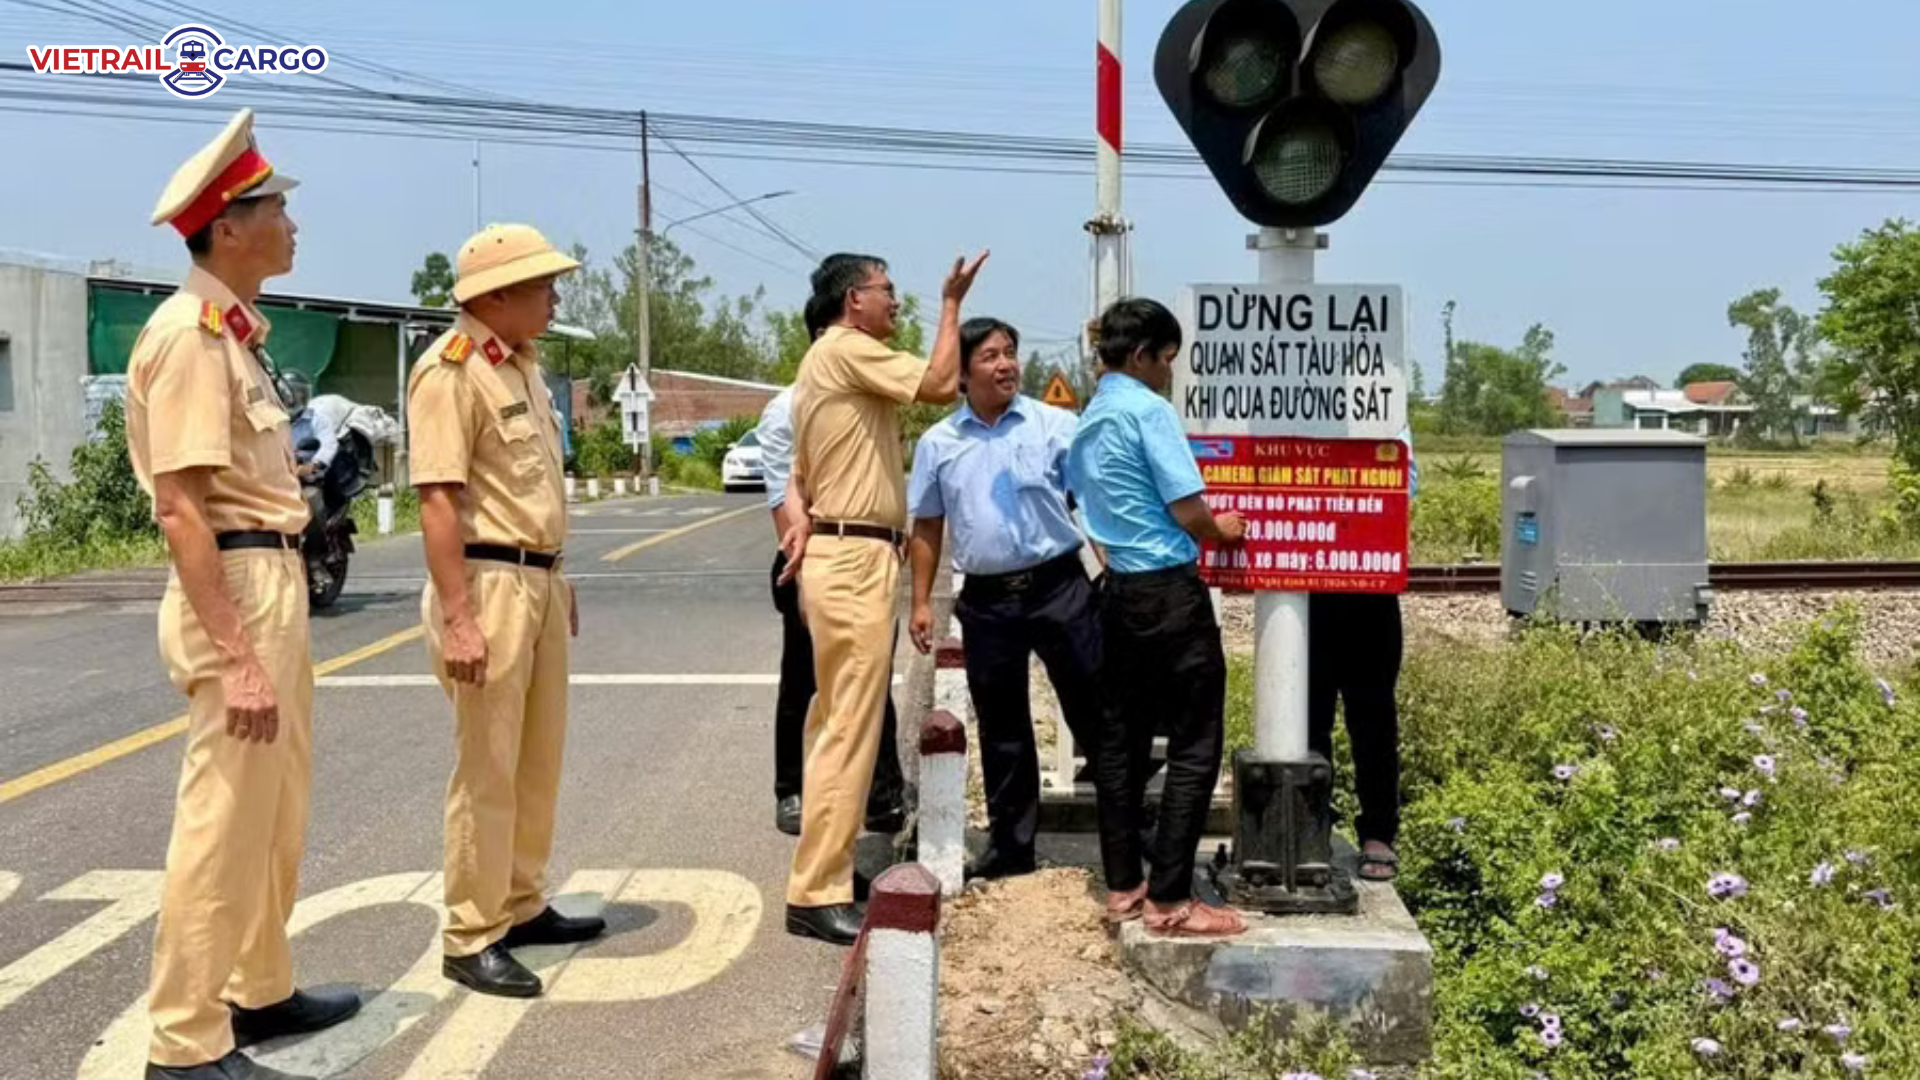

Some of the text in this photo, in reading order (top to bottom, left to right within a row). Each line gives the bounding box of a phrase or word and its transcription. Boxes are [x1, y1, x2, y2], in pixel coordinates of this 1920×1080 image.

[1198, 287, 1388, 334] DỪNG LẠI
[1190, 335, 1385, 377] QUAN SÁT TÀU HỎA
[1185, 385, 1217, 418] KHI
[1222, 386, 1265, 420] QUA
[1270, 379, 1346, 421] ĐƯỜNG
[1254, 443, 1330, 459] KHU VỰC
[1203, 464, 1256, 484] CAMERA
